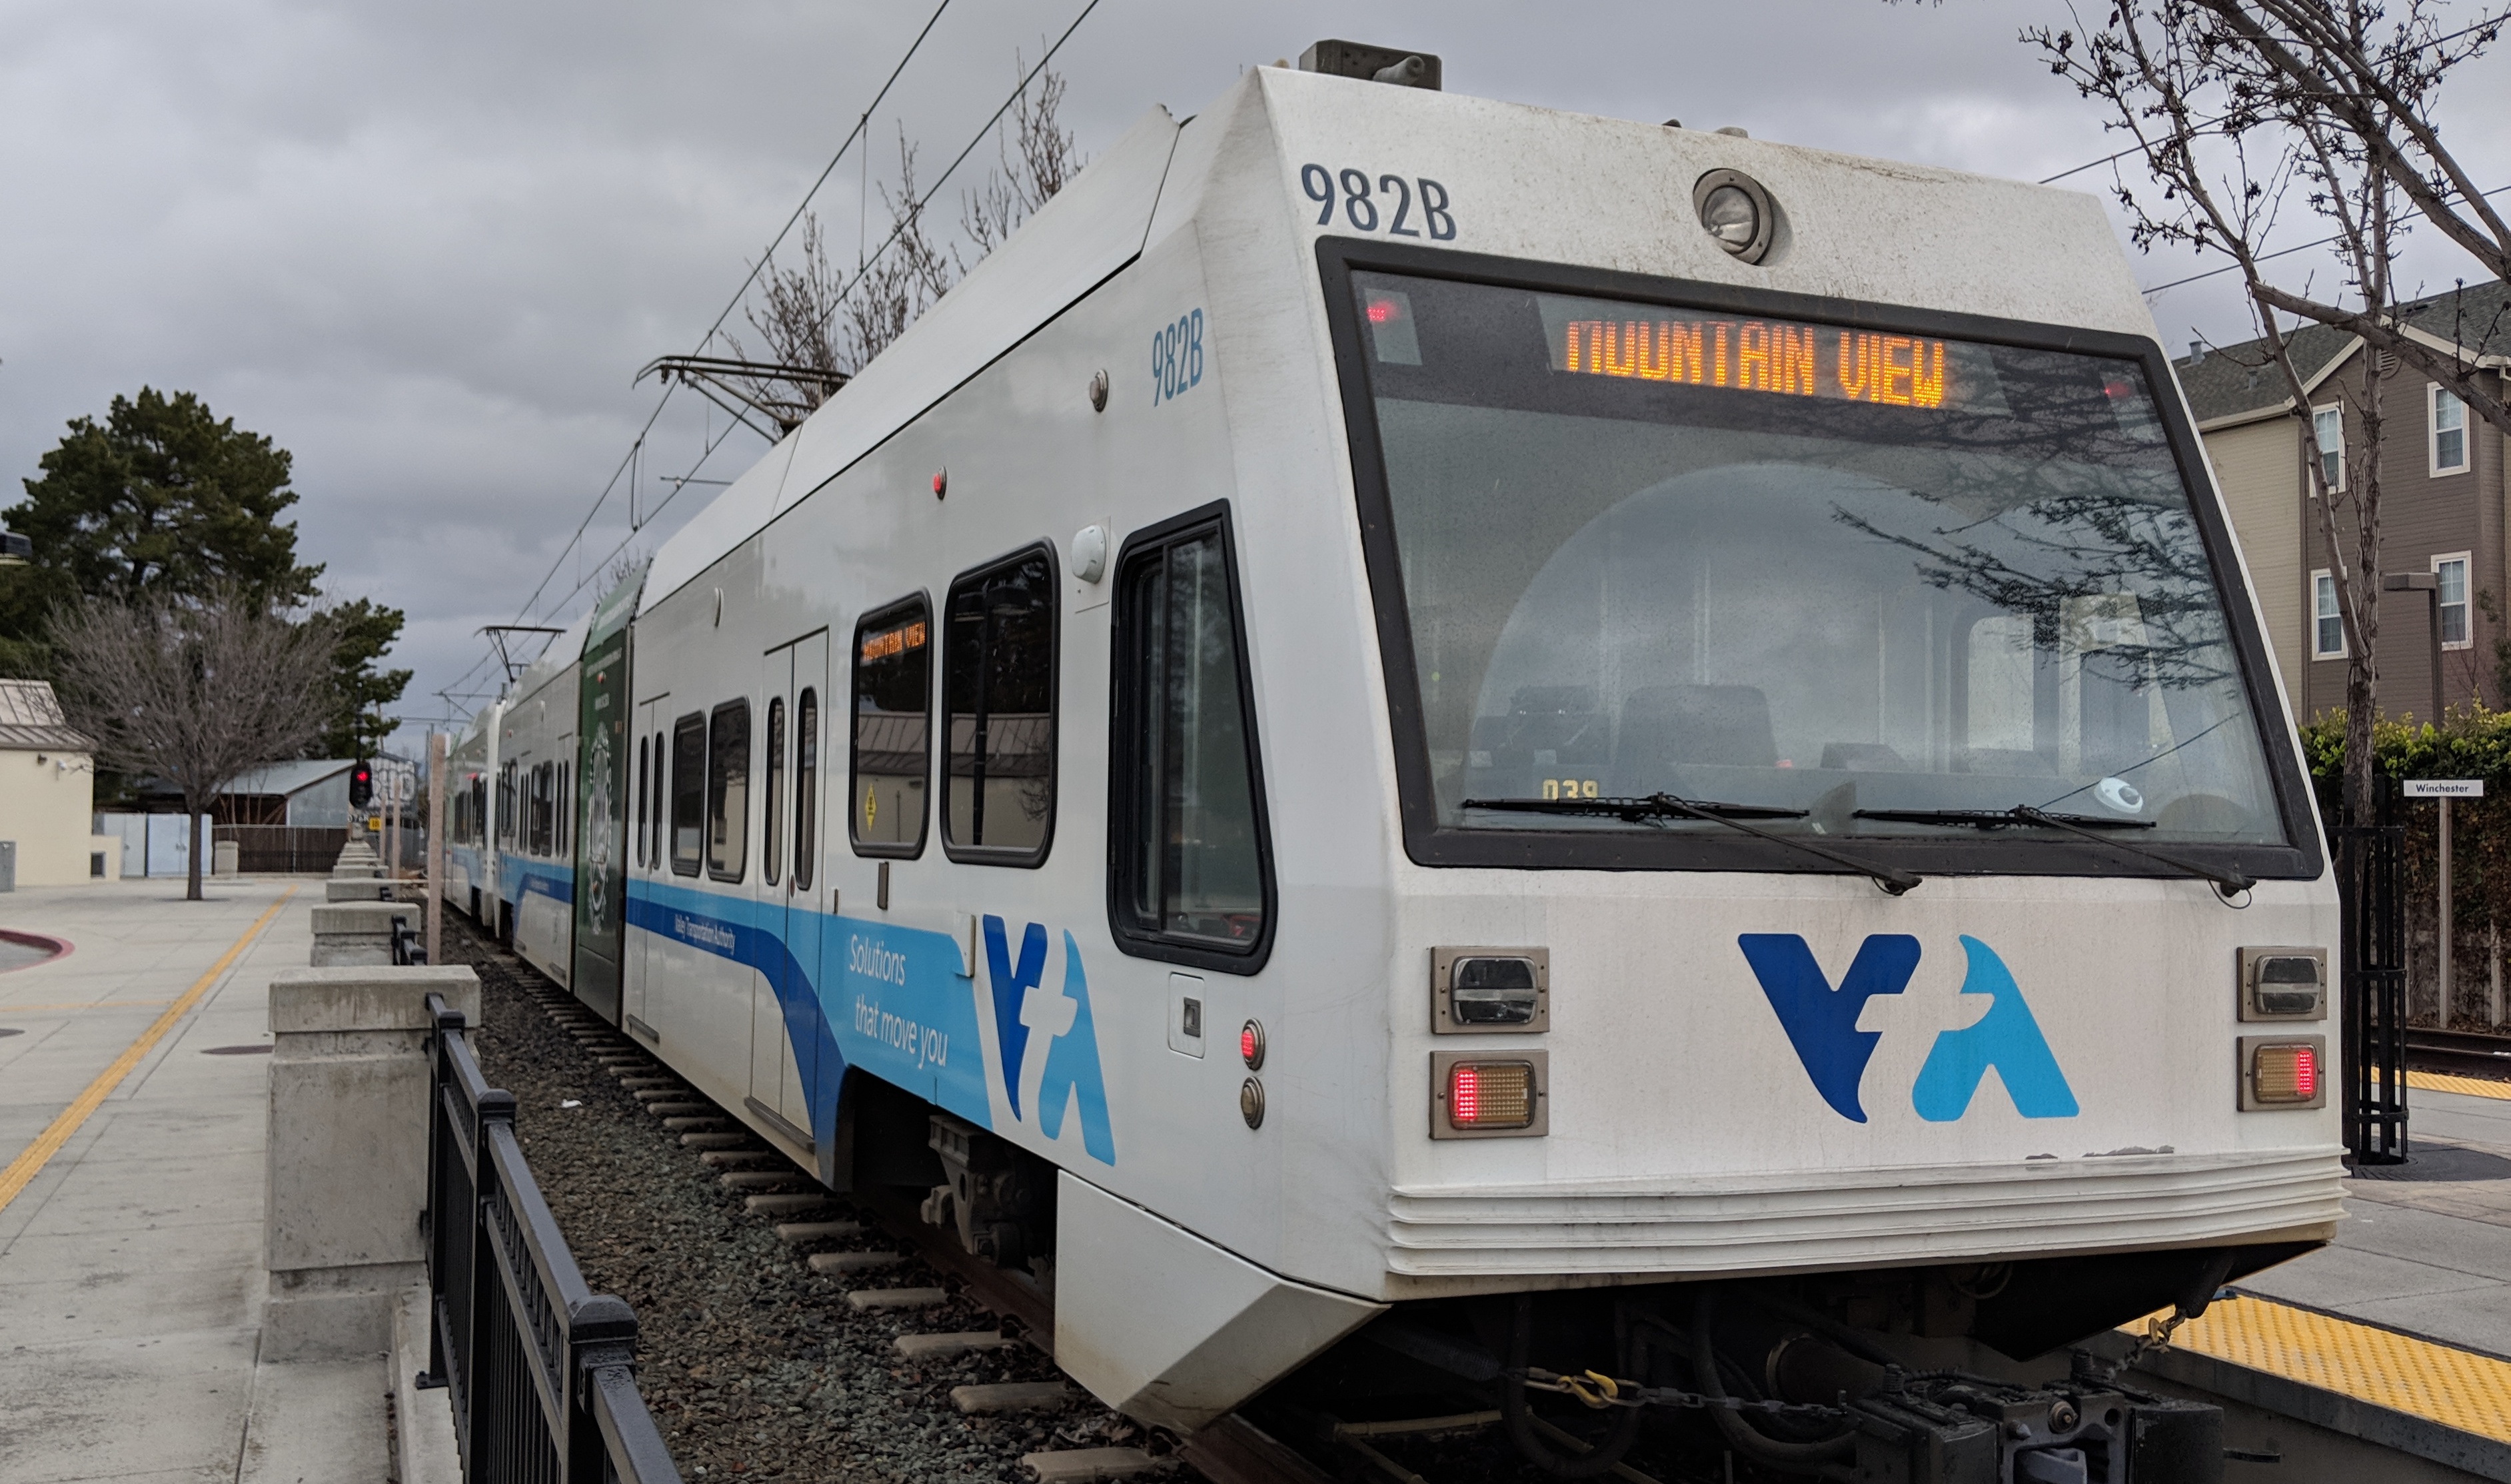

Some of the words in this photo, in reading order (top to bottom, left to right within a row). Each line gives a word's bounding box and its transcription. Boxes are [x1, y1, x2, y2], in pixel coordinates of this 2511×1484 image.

[1301, 163, 1457, 241] 982B
[1152, 307, 1204, 407] 982B
[1567, 321, 1814, 396] MOUNTAIN
[1838, 331, 1945, 409] VIEW
[2416, 783, 2468, 792] Winchester
[849, 934, 906, 986] Solutions
[855, 994, 880, 1040] that
[880, 1013, 917, 1055] move
[916, 1020, 949, 1070] you
